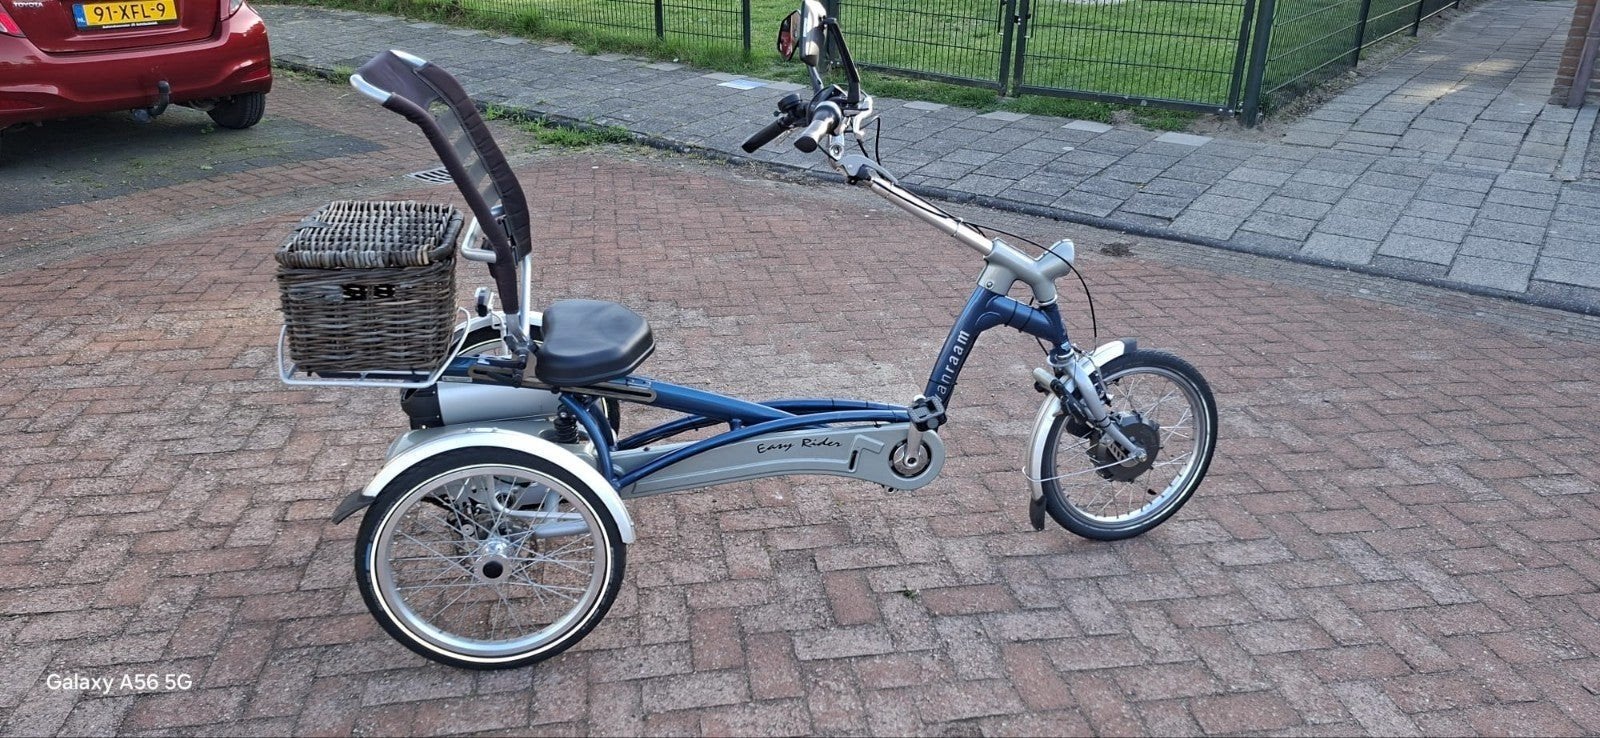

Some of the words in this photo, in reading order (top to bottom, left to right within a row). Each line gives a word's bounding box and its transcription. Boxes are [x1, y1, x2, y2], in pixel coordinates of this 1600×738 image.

[94, 3, 165, 22] 91-XFL-9
[757, 442, 795, 454] Easy
[801, 437, 842, 448] Rider
